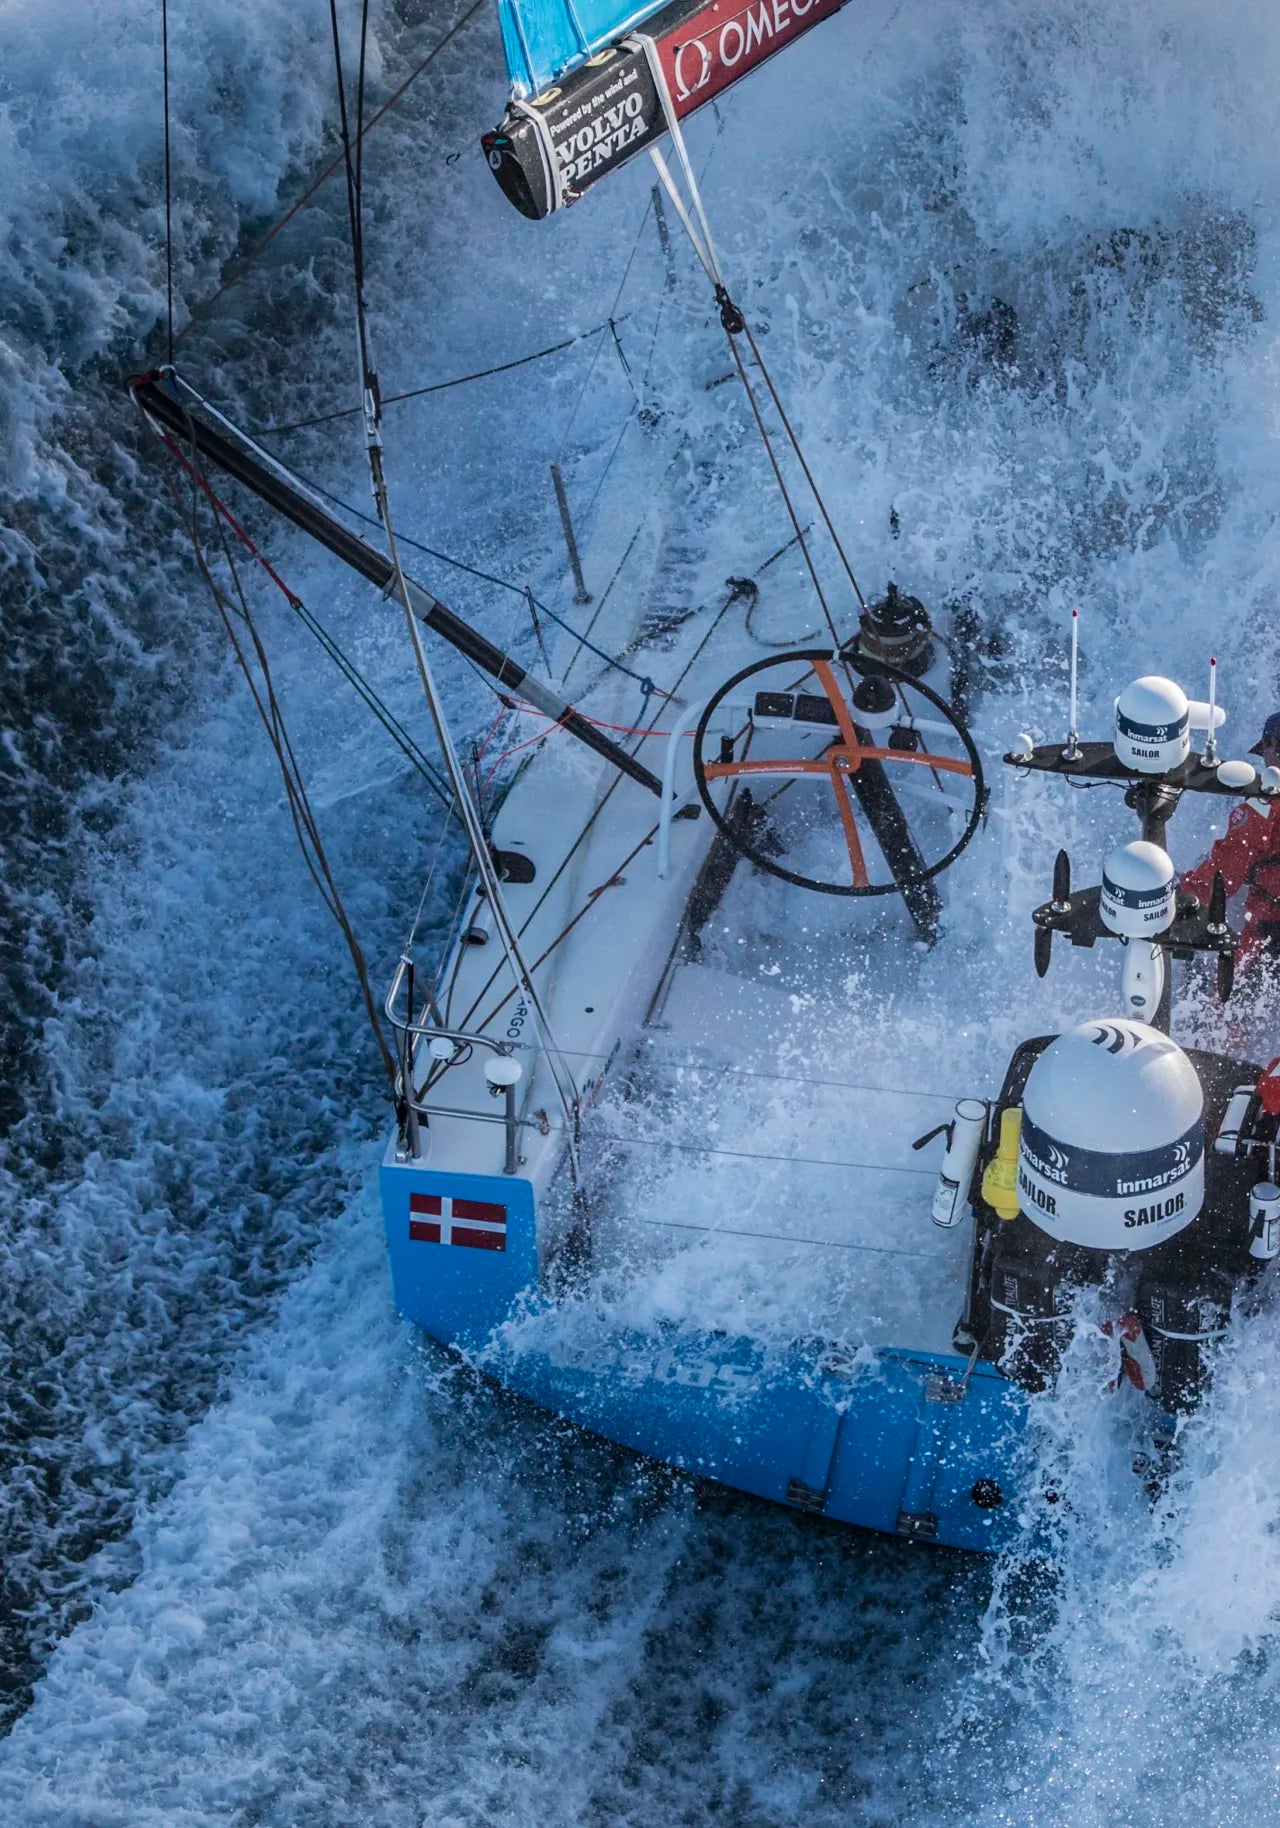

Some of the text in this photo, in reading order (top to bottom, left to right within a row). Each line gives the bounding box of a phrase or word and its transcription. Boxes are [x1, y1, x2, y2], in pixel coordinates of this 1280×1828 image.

[719, 0, 820, 66] OME
[550, 68, 638, 137] Powered by the wind and
[555, 92, 643, 164] VOLVO
[560, 115, 649, 190] PENTA
[1127, 728, 1168, 743] inmarsat
[1131, 746, 1160, 758] SAILOR
[1143, 906, 1168, 921] SAILOR
[1117, 1157, 1191, 1195] inmarsat
[1124, 1192, 1184, 1228] SAILOR
